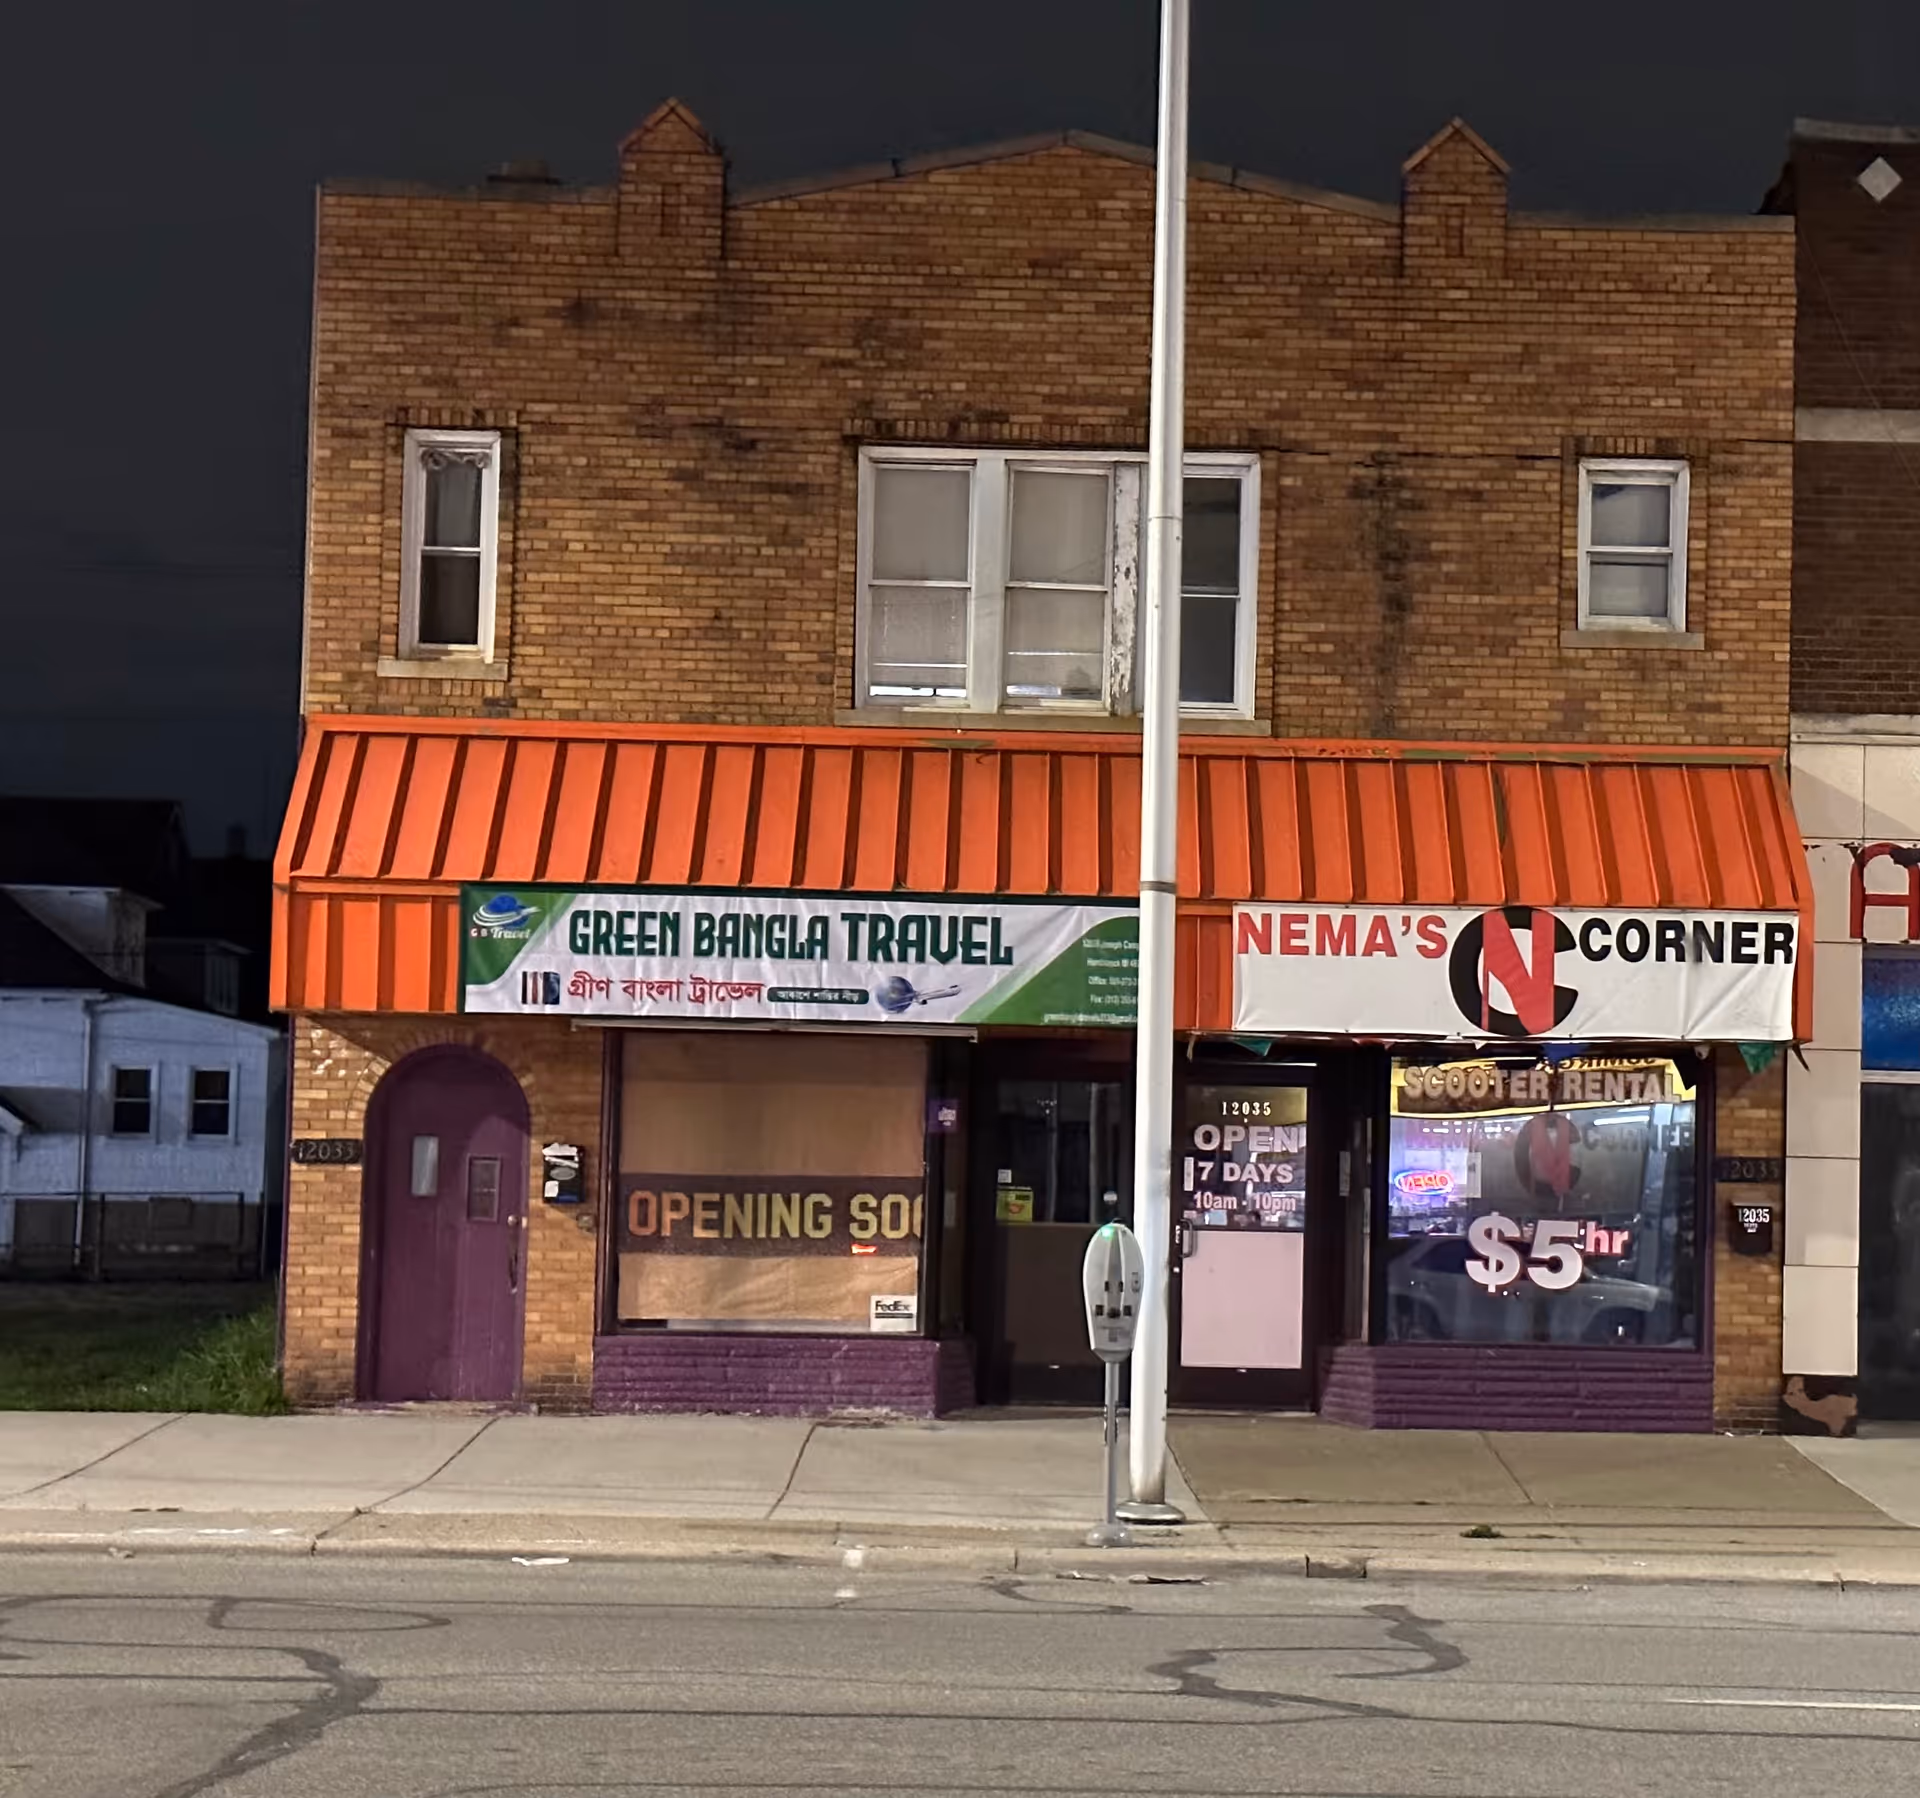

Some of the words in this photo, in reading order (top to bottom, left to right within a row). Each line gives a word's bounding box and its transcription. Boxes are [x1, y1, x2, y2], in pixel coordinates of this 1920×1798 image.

[569, 909, 679, 957] GREEN
[693, 911, 830, 960] BANGLA
[840, 912, 1014, 966] TRAVEL
[1237, 912, 1448, 959] NEMA'S
[1579, 917, 1795, 965] CORNER
[620, 976, 684, 1003] বাংলা
[687, 973, 765, 1005] ট্রাভেল
[1404, 1066, 1550, 1099] SCOOTER
[1563, 1070, 1681, 1104] RENTAL
[1222, 1101, 1272, 1116] 12035
[1193, 1124, 1299, 1153] OPEN
[1198, 1161, 1214, 1181] 7
[1223, 1162, 1294, 1183] DAYS
[1722, 1160, 1780, 1179] 2035
[628, 1190, 833, 1239] OPENING
[1193, 1191, 1238, 1210] 10am
[1252, 1192, 1297, 1213] 10pm
[1738, 1208, 1770, 1223] 12035
[1465, 1211, 1583, 1293] $5
[875, 1300, 911, 1312] FedEx
